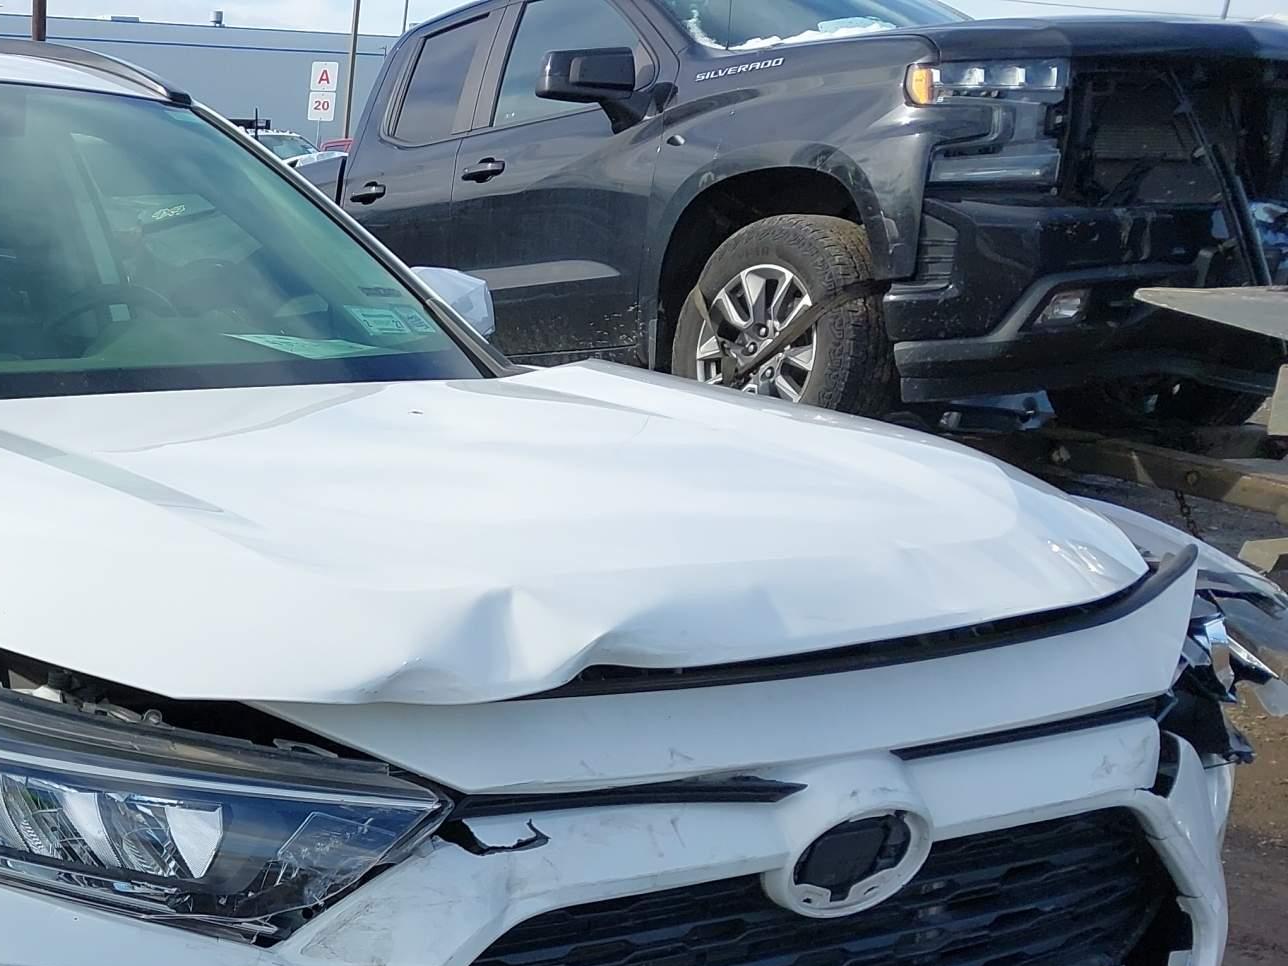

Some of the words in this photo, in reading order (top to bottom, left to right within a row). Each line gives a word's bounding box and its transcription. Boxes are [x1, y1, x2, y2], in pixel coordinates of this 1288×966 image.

[318, 69, 330, 85] A
[695, 57, 785, 82] SILVERADO
[313, 100, 330, 111] 20
